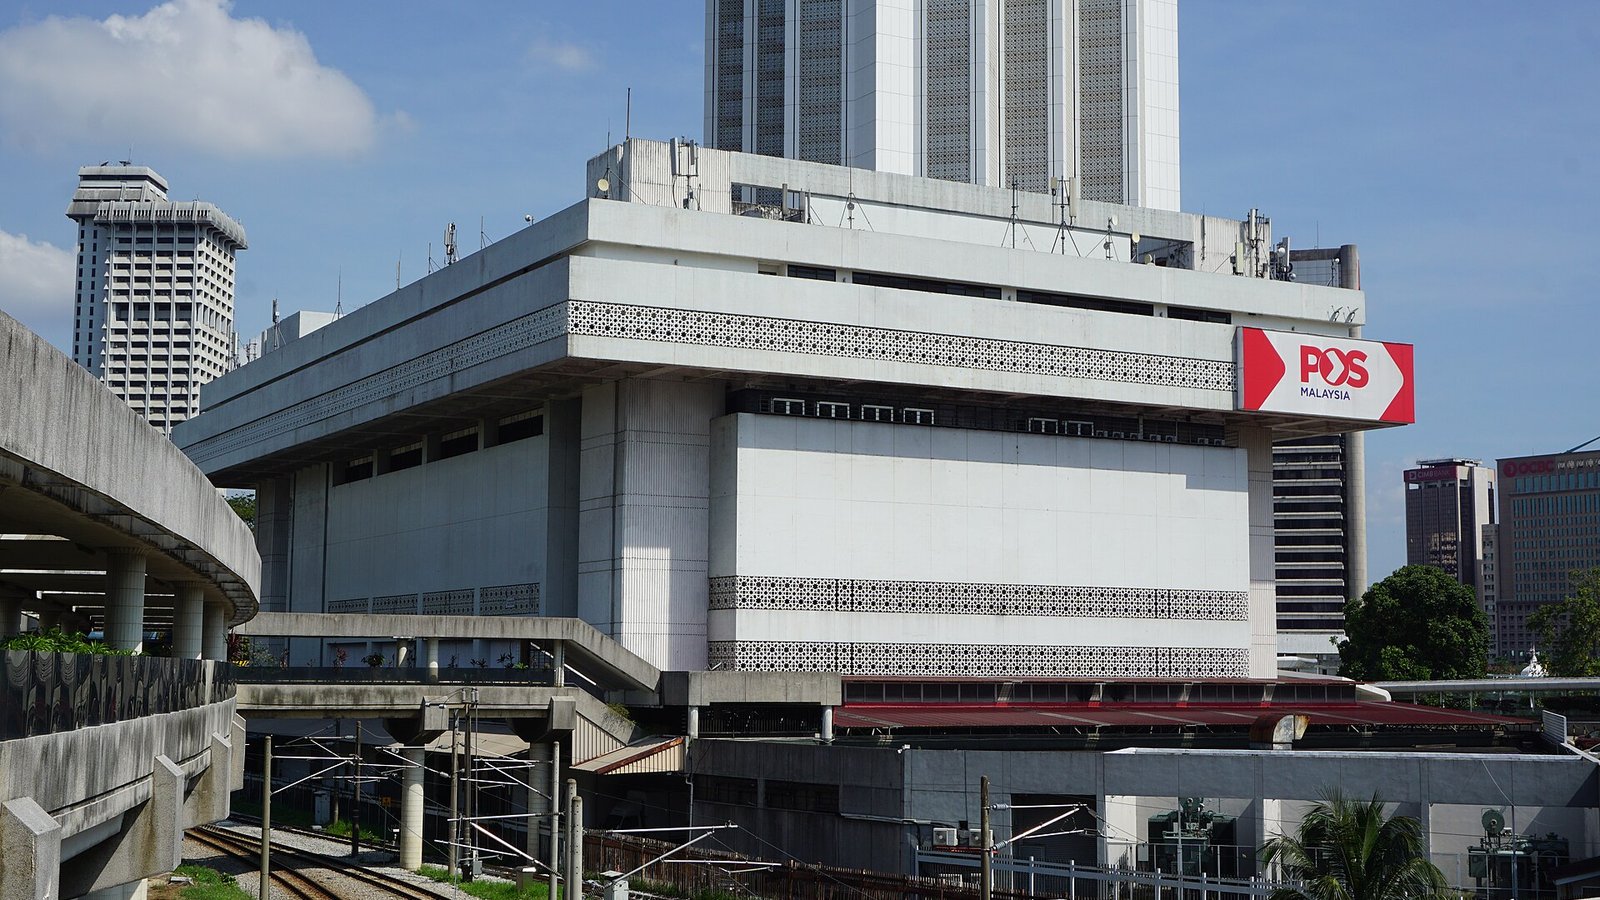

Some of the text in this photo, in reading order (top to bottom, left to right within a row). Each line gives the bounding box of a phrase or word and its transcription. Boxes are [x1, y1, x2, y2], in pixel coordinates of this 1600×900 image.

[1300, 345, 1369, 388] POS
[1300, 387, 1350, 401] MALAYSIA
[1518, 459, 1555, 474] OCBC
